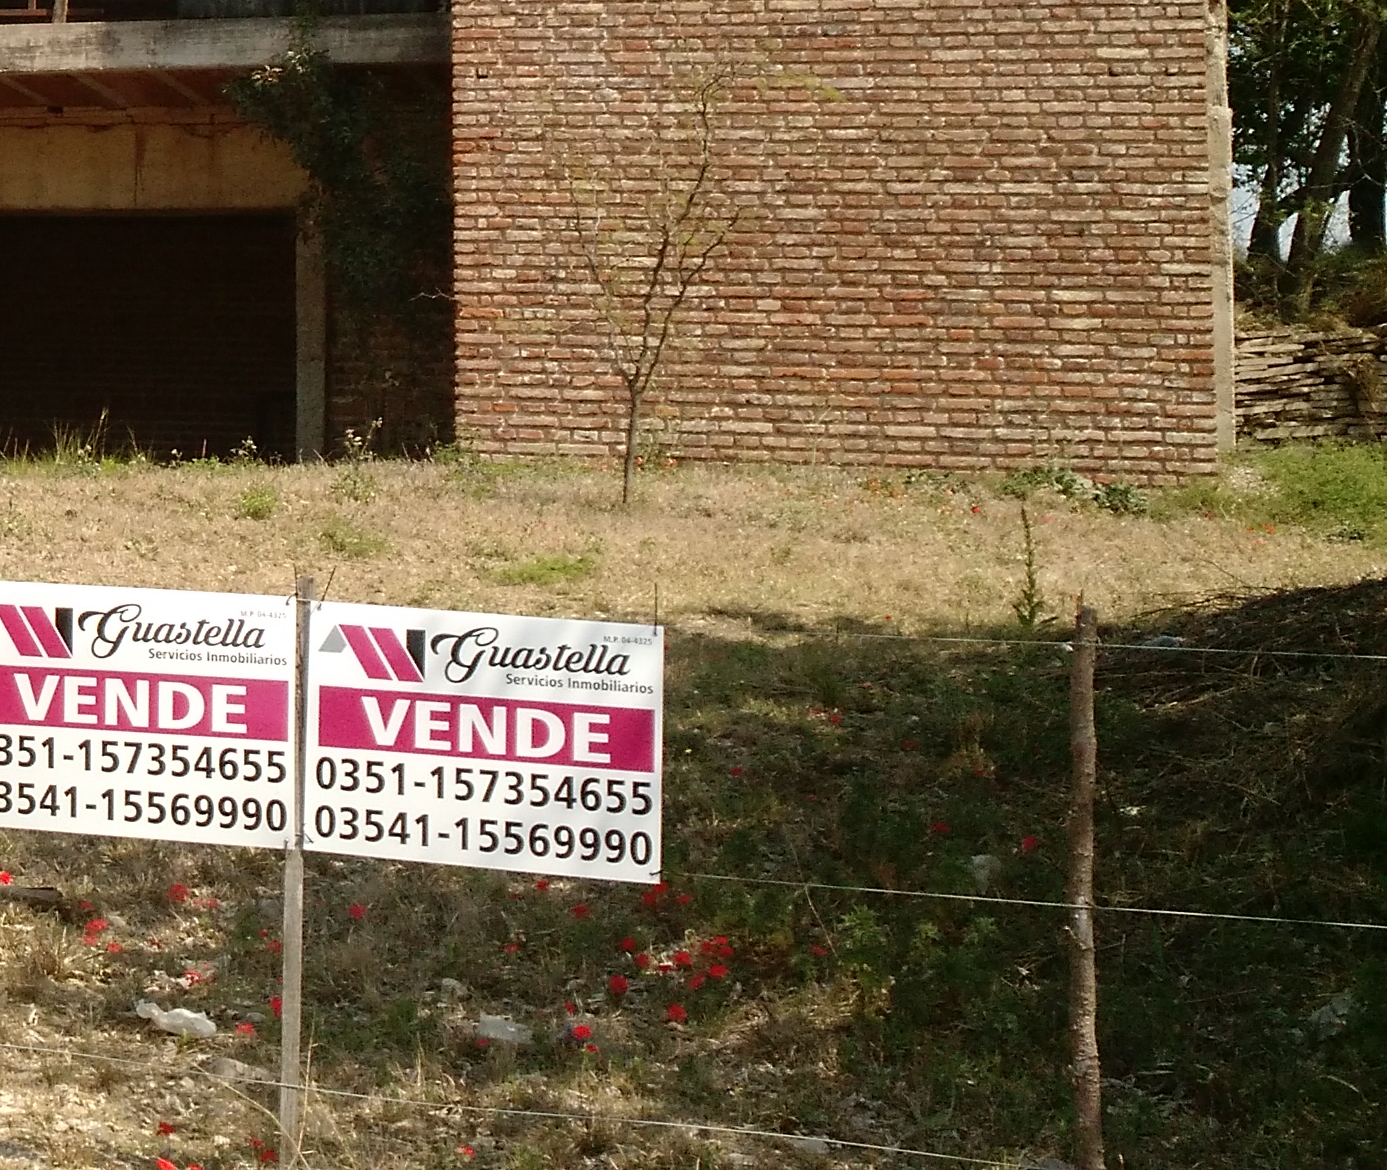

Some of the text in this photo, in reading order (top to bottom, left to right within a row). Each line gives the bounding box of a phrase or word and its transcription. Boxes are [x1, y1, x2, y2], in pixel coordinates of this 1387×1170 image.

[78, 603, 266, 659] Guastella
[148, 648, 288, 666] Servicios Inmobiliarios
[430, 627, 631, 684] Guastella
[13, 672, 248, 734] VENDE
[506, 673, 654, 695] Servicios Inmobiliarios
[360, 696, 612, 764] VENDE
[315, 756, 653, 816] 0351-157354655
[314, 804, 653, 865] 03541-15569990
